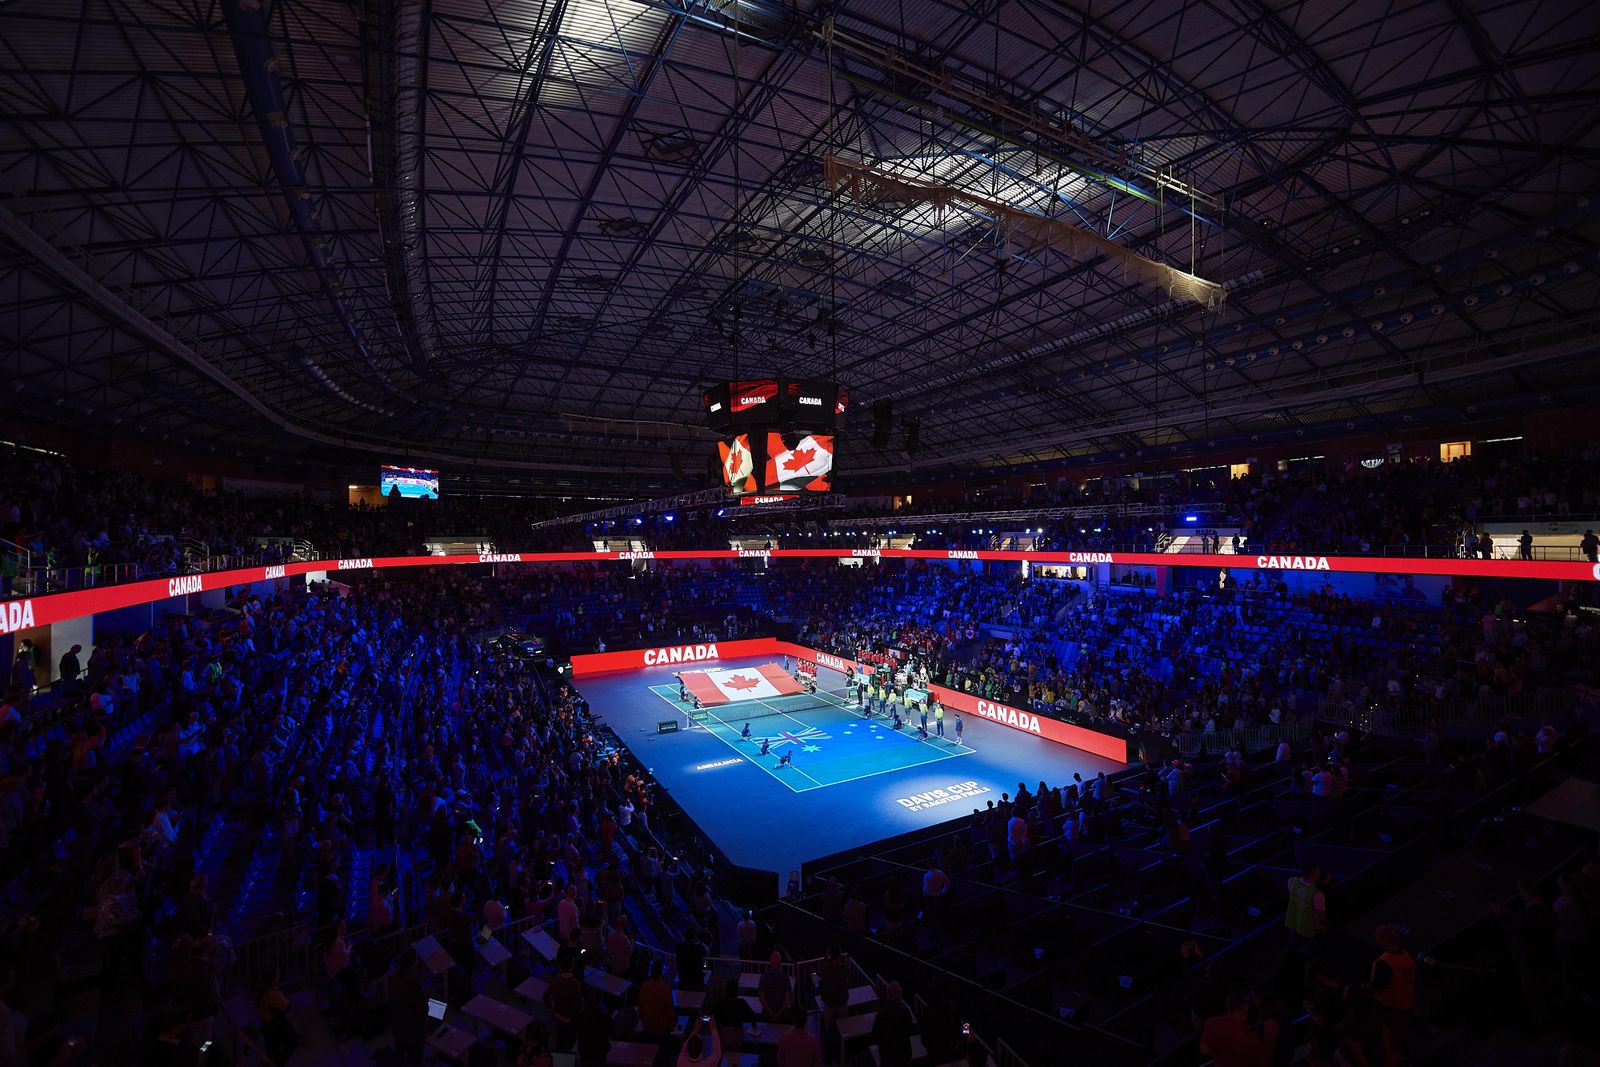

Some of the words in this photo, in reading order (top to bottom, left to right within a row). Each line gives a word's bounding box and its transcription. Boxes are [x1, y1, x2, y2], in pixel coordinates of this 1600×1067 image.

[741, 396, 766, 405] CANADA
[798, 396, 822, 406] CANADA
[479, 553, 521, 563] CANADA
[619, 551, 655, 559] CANADA
[738, 550, 771, 558] CANADA
[852, 549, 882, 557] CANADA
[948, 550, 979, 560] CANADA
[1069, 552, 1114, 564] CANADA
[338, 558, 374, 570] CANADA
[1257, 555, 1331, 571] CANADA
[168, 575, 203, 597] CANADA
[644, 644, 719, 666] CANADA
[816, 653, 845, 671] CANADA
[977, 701, 1041, 733] CANADA
[896, 790, 949, 808] DAVIS
[946, 781, 979, 794] CUP
